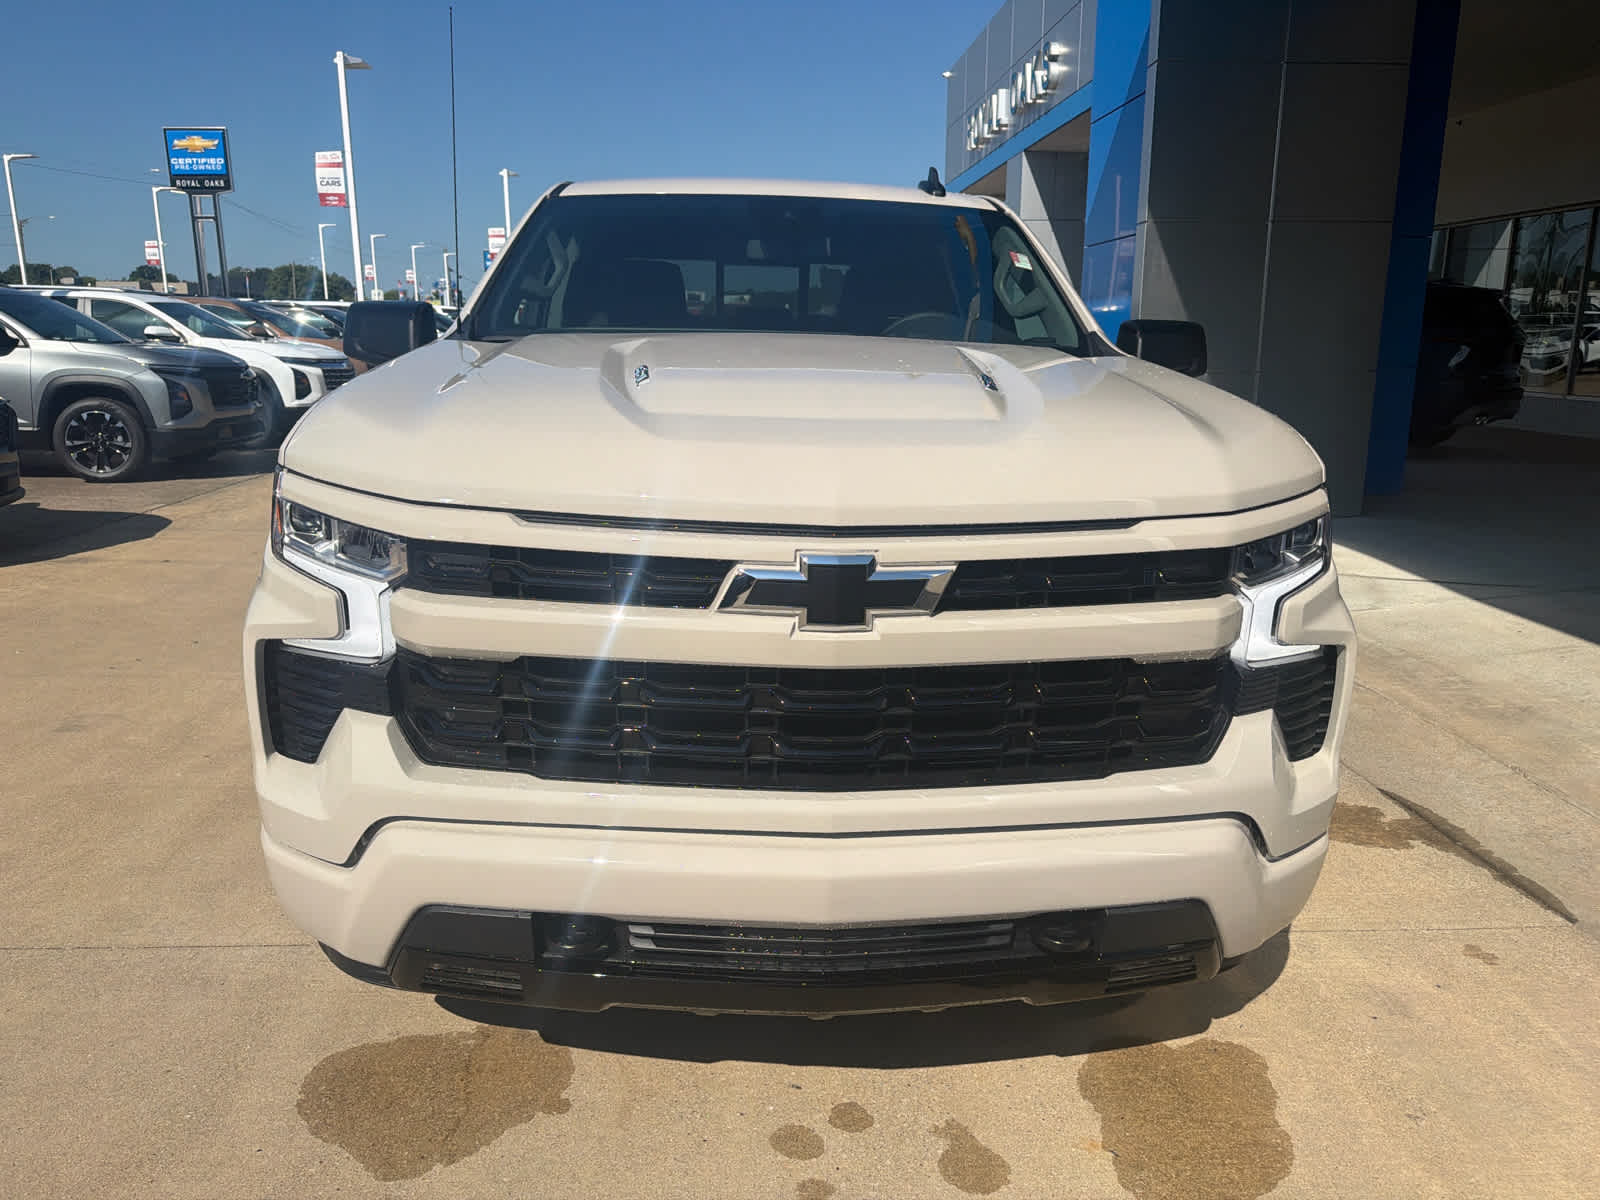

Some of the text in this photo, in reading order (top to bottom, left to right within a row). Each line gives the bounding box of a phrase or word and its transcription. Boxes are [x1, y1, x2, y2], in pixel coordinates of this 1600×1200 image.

[171, 157, 225, 165] CERTIFIED
[176, 179, 225, 187] ROYAL OAKS
